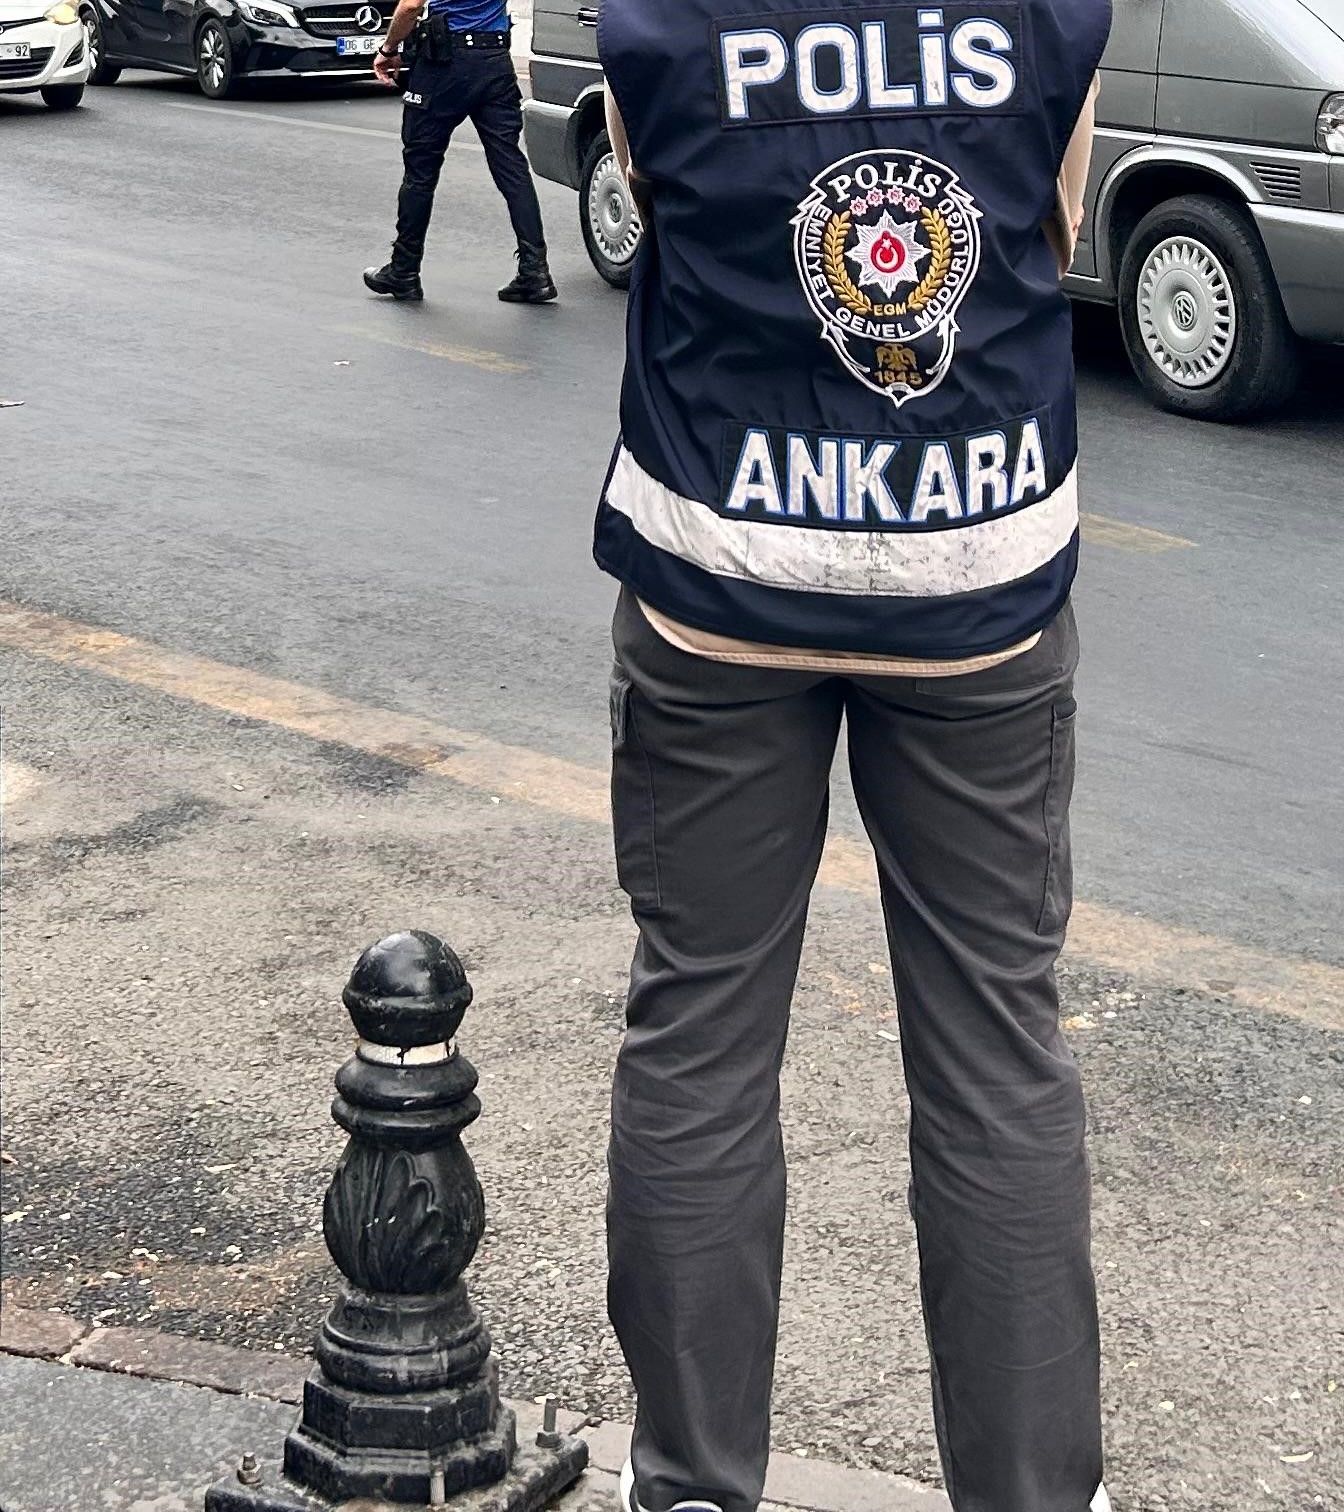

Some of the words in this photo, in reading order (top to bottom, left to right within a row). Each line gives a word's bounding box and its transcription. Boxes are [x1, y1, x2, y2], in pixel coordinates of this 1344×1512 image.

[835, 306, 911, 338] GENEL
[872, 303, 907, 317] EGM
[873, 369, 923, 386] 1845
[723, 416, 1048, 522] ANKARA
